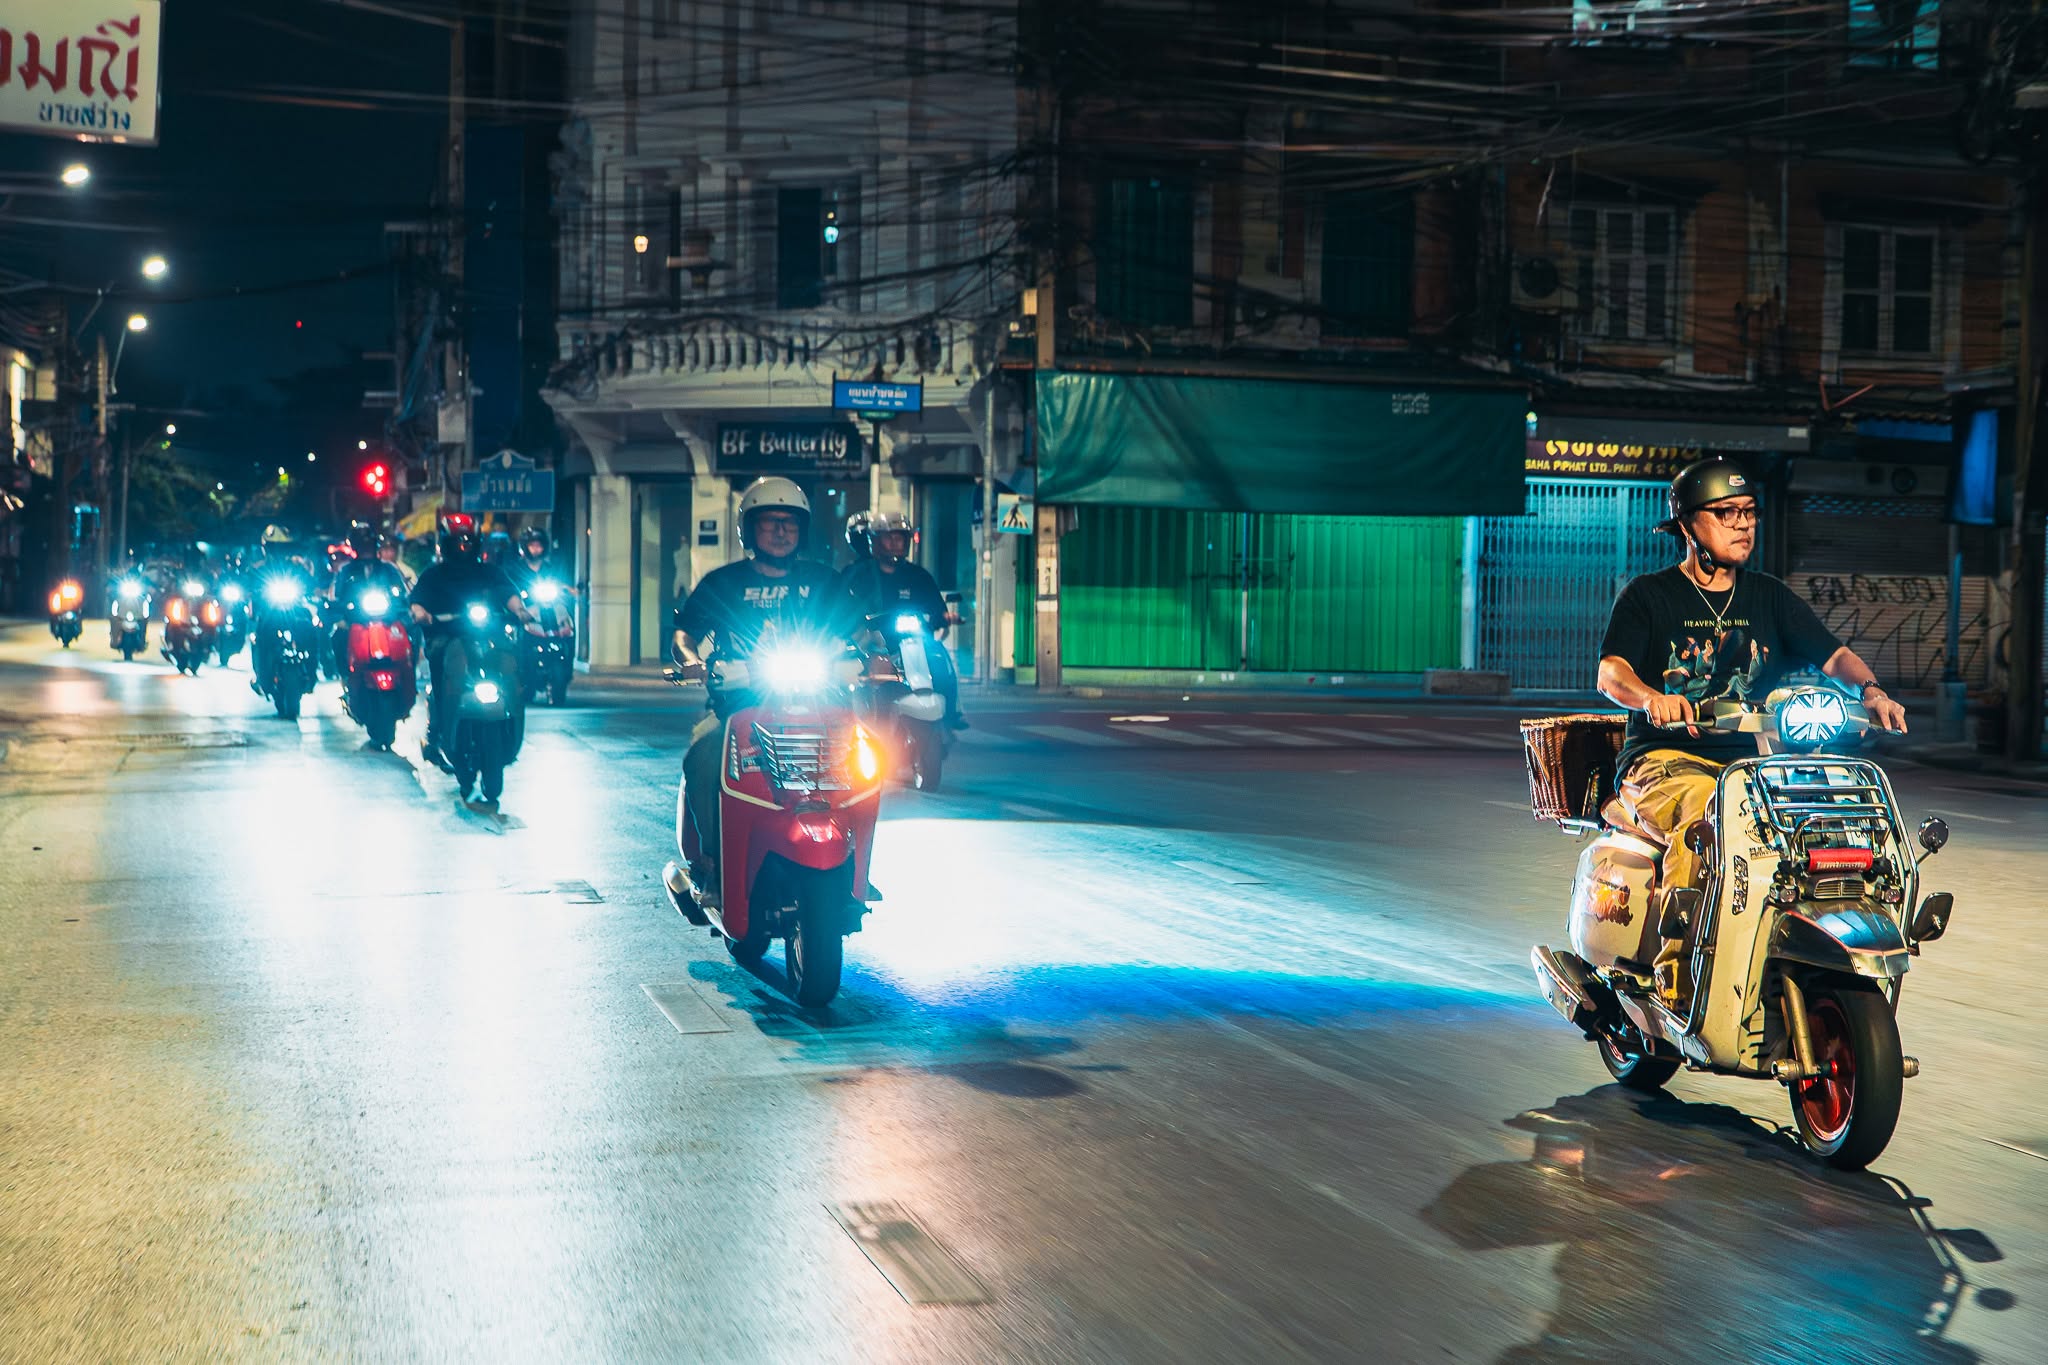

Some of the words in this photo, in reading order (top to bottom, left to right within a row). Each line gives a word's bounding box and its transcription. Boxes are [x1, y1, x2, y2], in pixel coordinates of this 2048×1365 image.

[721, 429, 750, 455] BF
[1524, 459, 1550, 470] SAHA
[1553, 459, 1588, 472] PIPHAT
[1684, 620, 1715, 628] HEAVEN
